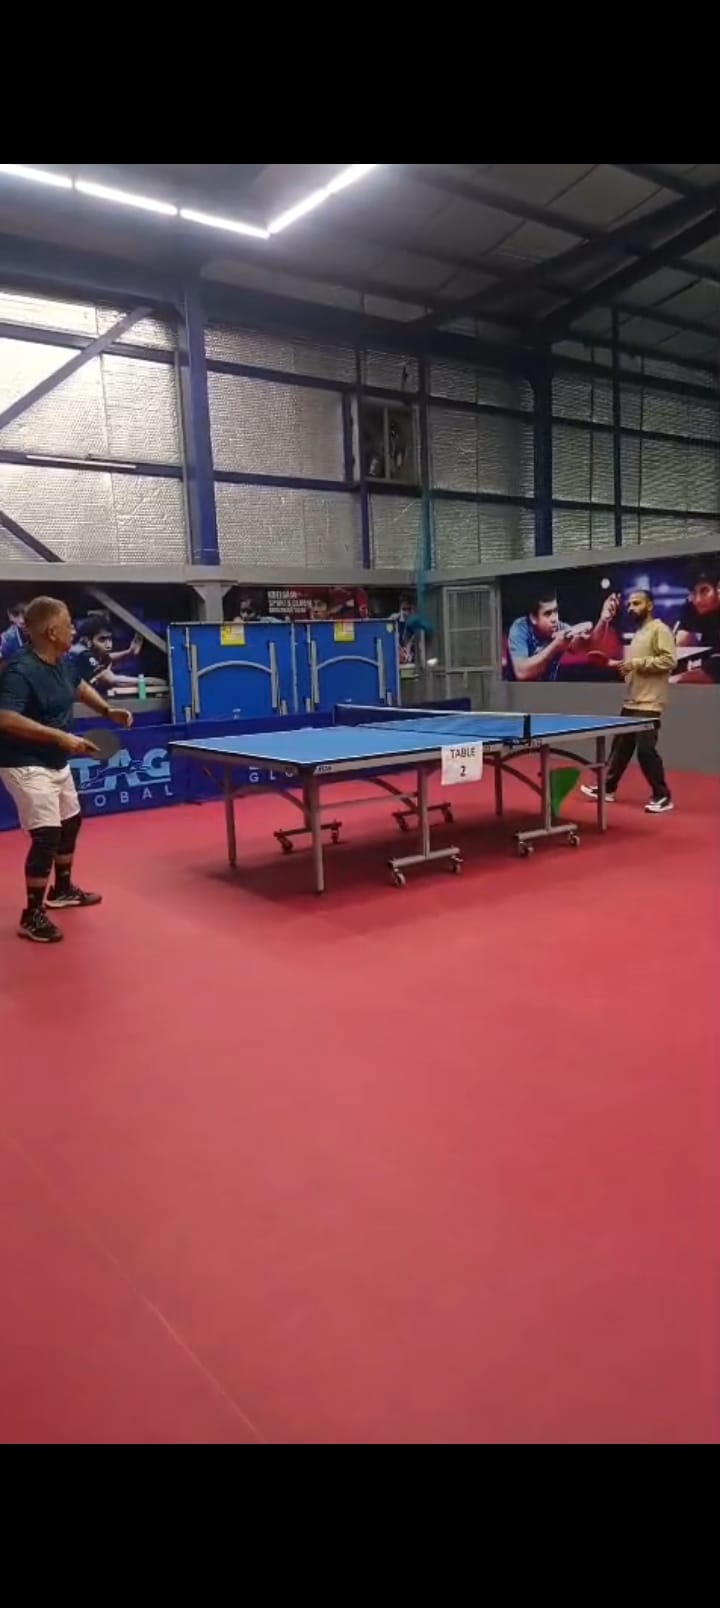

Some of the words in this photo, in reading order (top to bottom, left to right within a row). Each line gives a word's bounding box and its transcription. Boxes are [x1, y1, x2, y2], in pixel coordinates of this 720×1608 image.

[450, 747, 476, 759] TABLE
[67, 748, 171, 793] TAG
[460, 765, 466, 777] 2
[94, 784, 173, 807] OBAL
